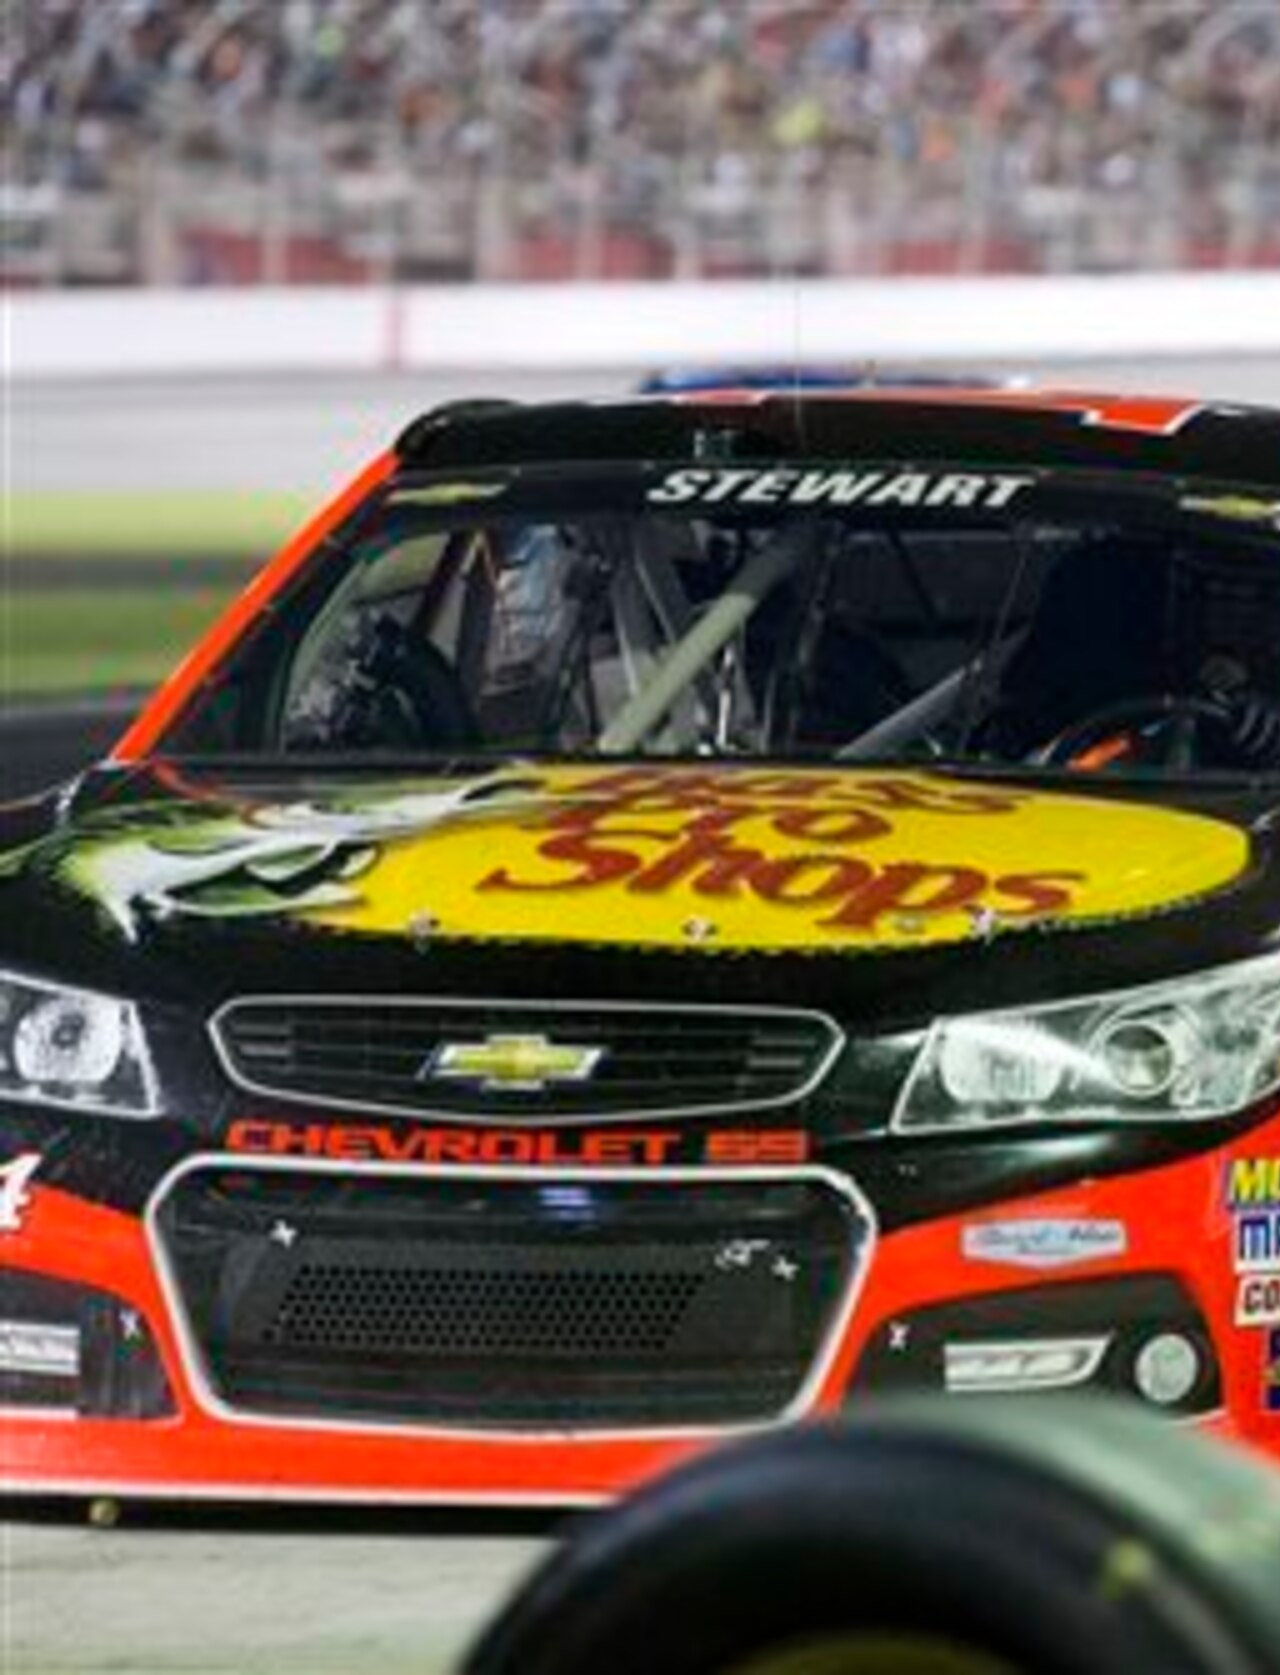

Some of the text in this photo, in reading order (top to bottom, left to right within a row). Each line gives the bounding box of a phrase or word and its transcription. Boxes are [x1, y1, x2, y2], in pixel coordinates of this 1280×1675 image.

[646, 466, 1036, 507] STEWART
[475, 828, 1088, 931] Shops
[224, 1118, 682, 1167] CHEVROLET
